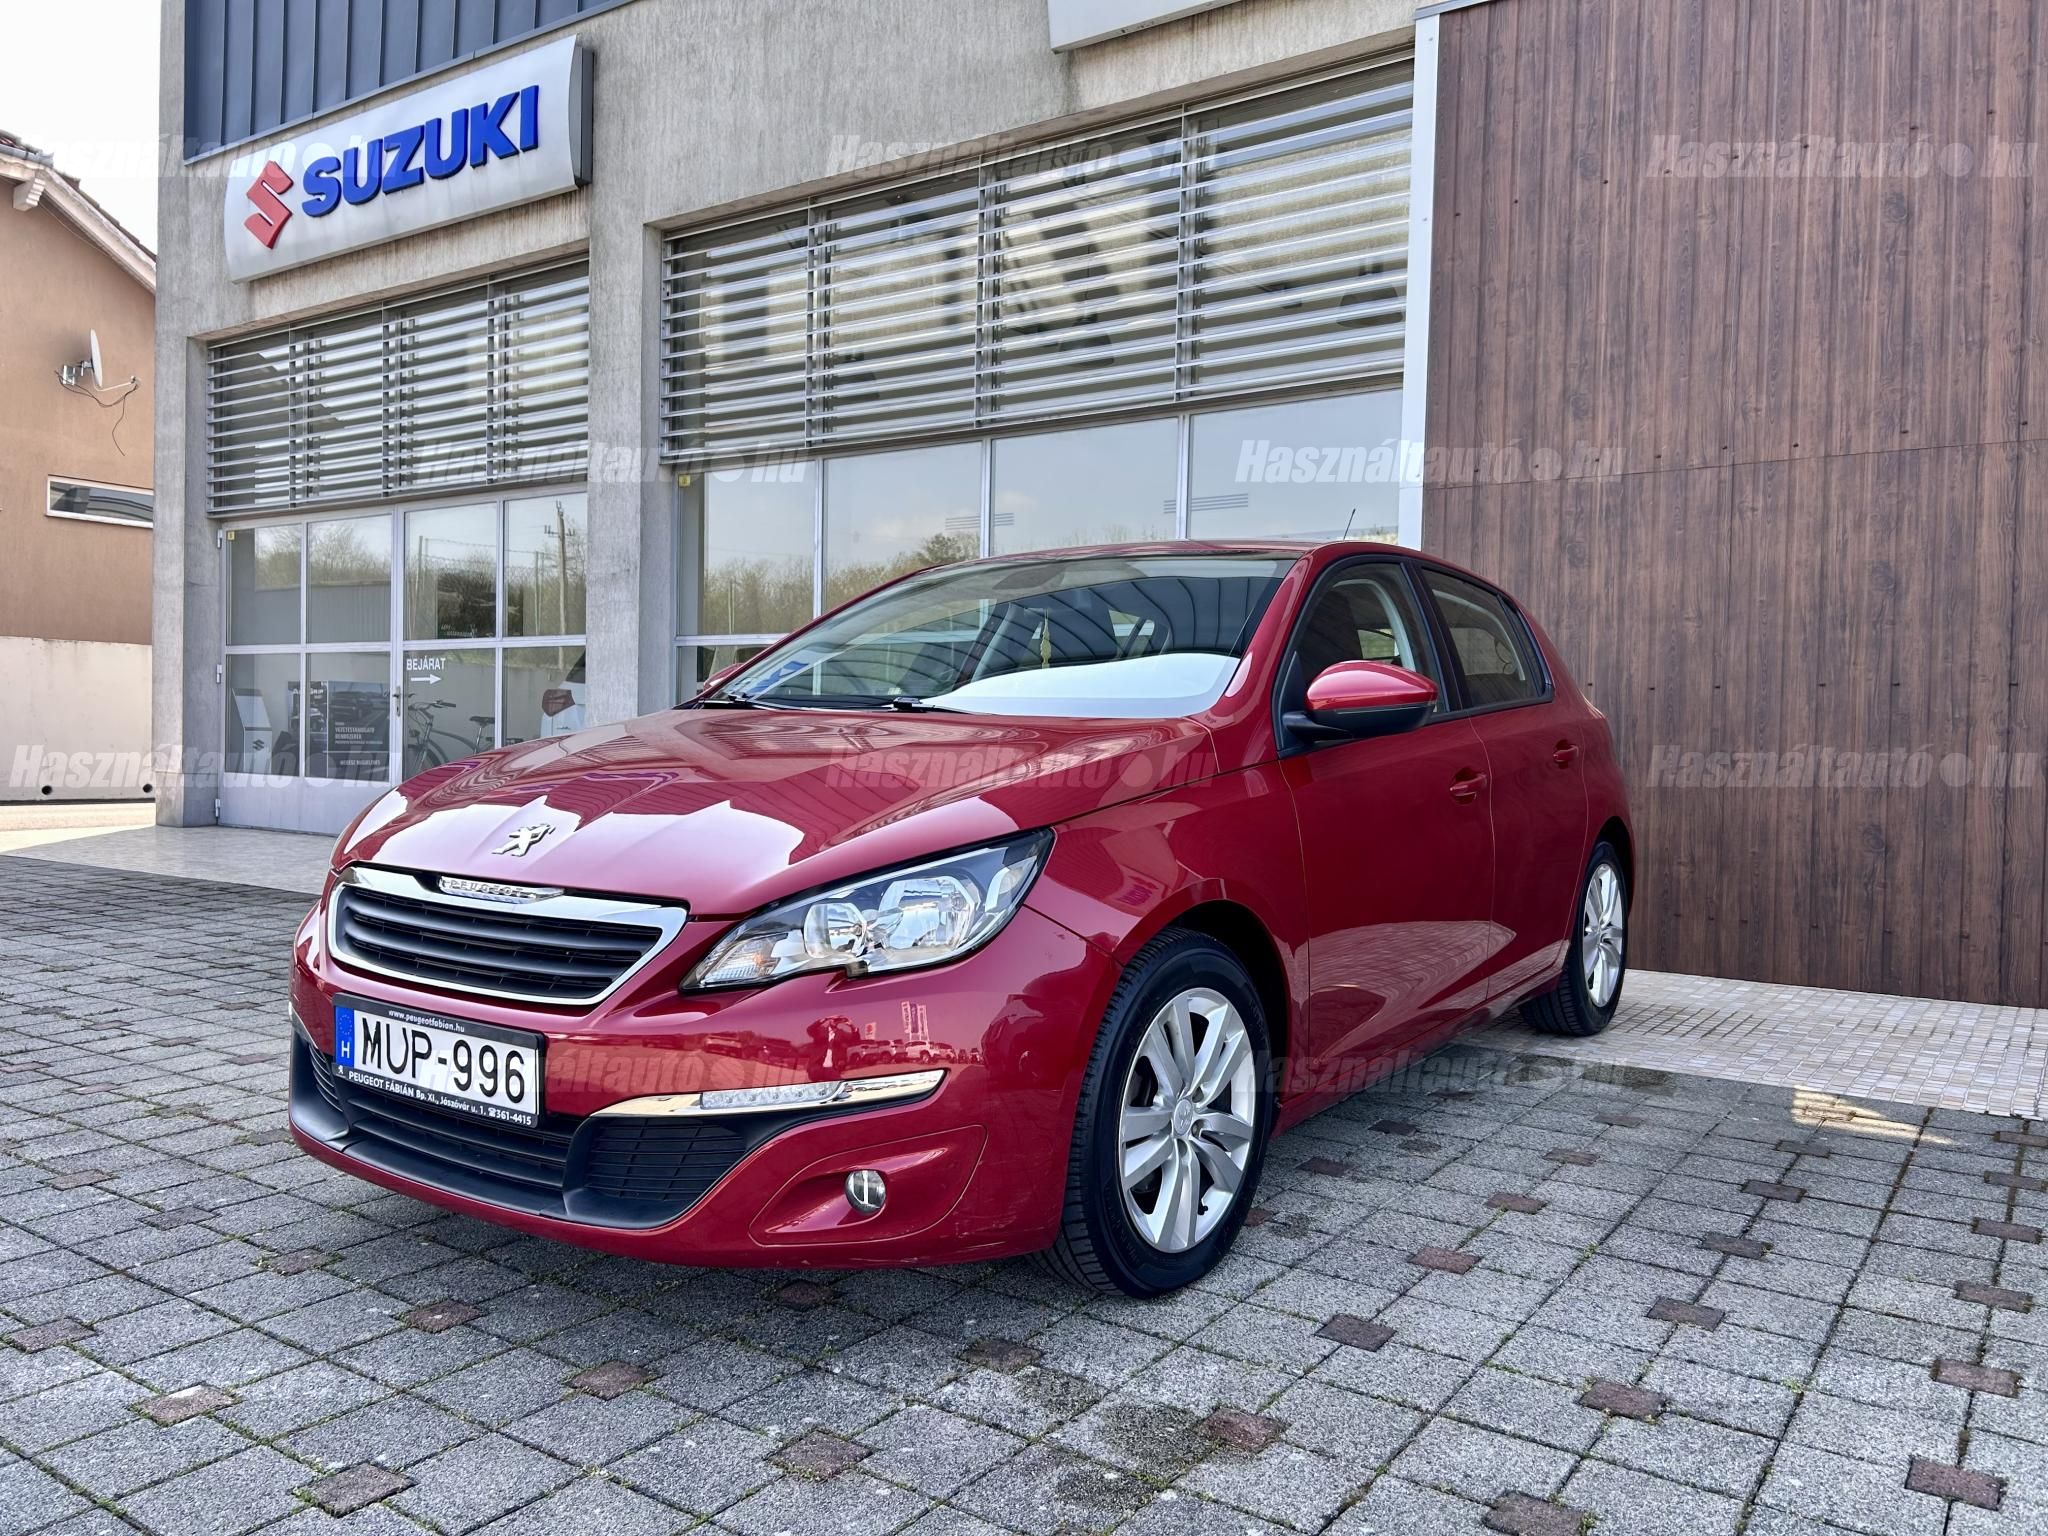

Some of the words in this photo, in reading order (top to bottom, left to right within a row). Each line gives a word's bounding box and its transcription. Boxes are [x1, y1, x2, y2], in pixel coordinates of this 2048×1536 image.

[302, 84, 539, 218] SUZUKI
[406, 655, 446, 671] BEJÁRAT
[449, 879, 524, 897] PEUGEOT
[388, 1010, 465, 1033] www.peugeotfabian.hu
[341, 1040, 350, 1059] H
[361, 1017, 525, 1104] MUP-996
[349, 1071, 384, 1089] PEUGEOT
[385, 1080, 414, 1097] FÁBIÁN
[416, 1090, 427, 1101] Bp.
[471, 1105, 478, 1113] u.
[480, 1106, 486, 1115] 1.
